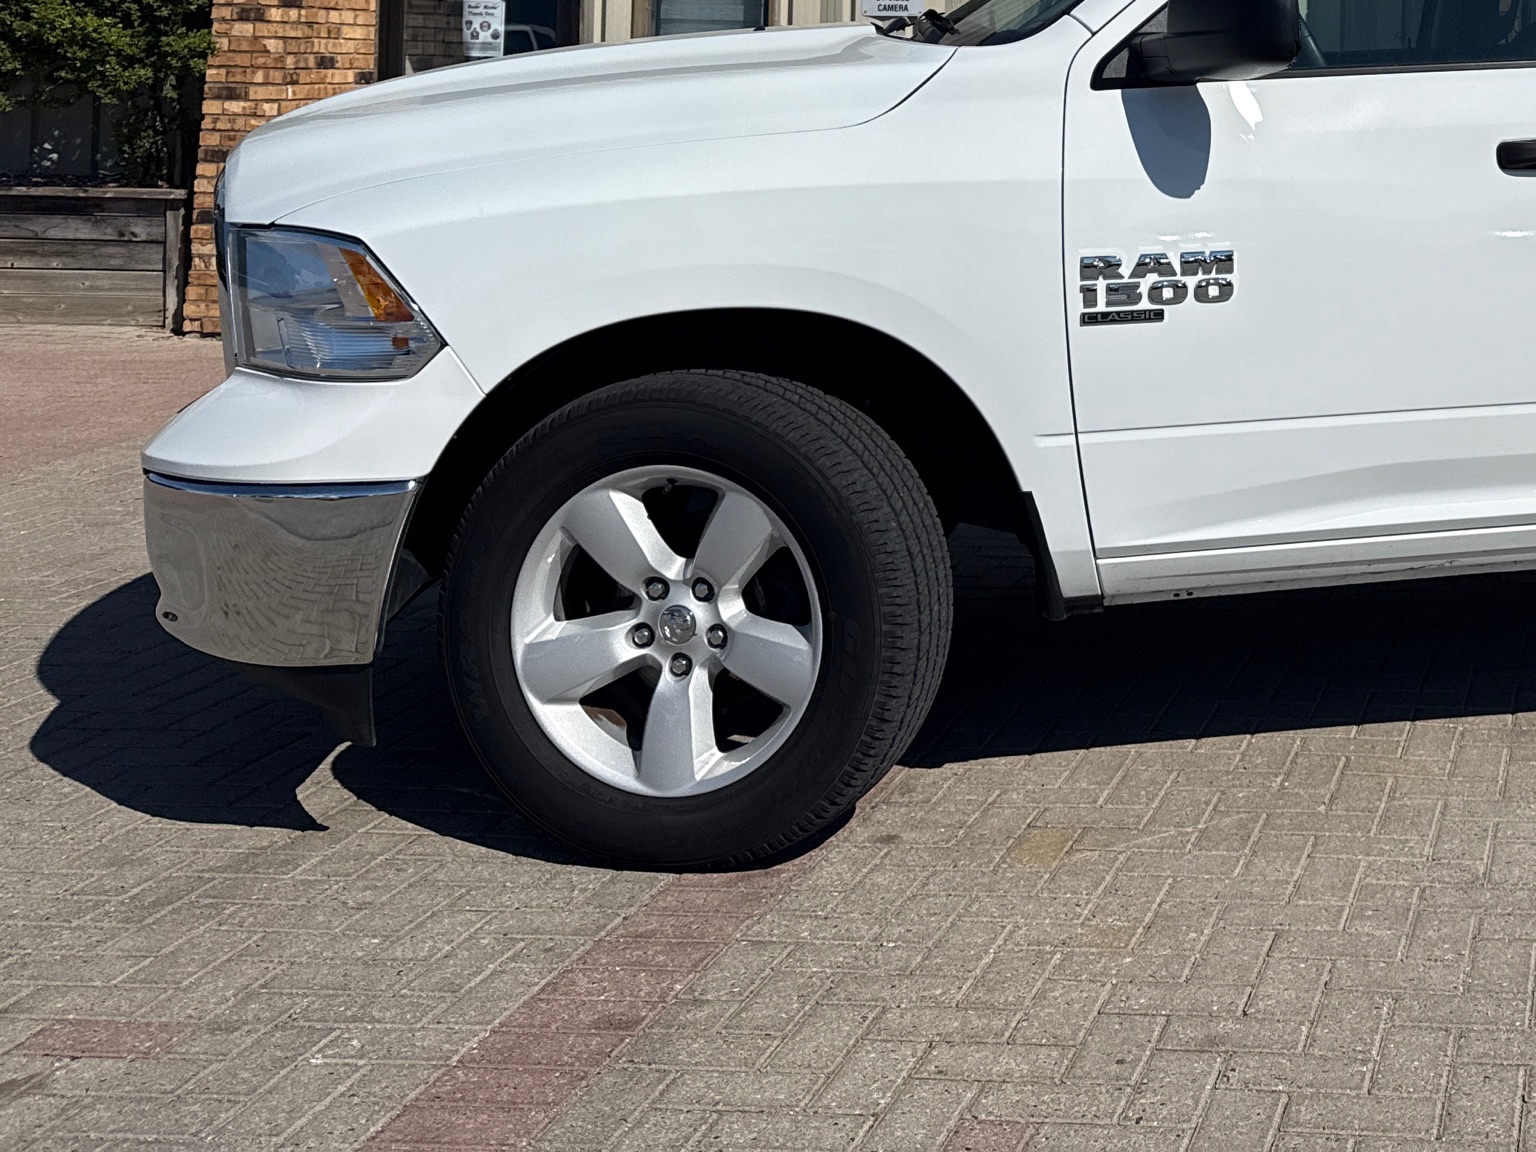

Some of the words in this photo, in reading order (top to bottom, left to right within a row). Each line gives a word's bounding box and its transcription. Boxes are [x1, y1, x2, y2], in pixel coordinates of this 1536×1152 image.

[877, 4, 909, 12] CAMERA
[1080, 250, 1235, 282] RAM
[1079, 277, 1235, 309] 1500
[1084, 310, 1164, 323] CLASSIC
